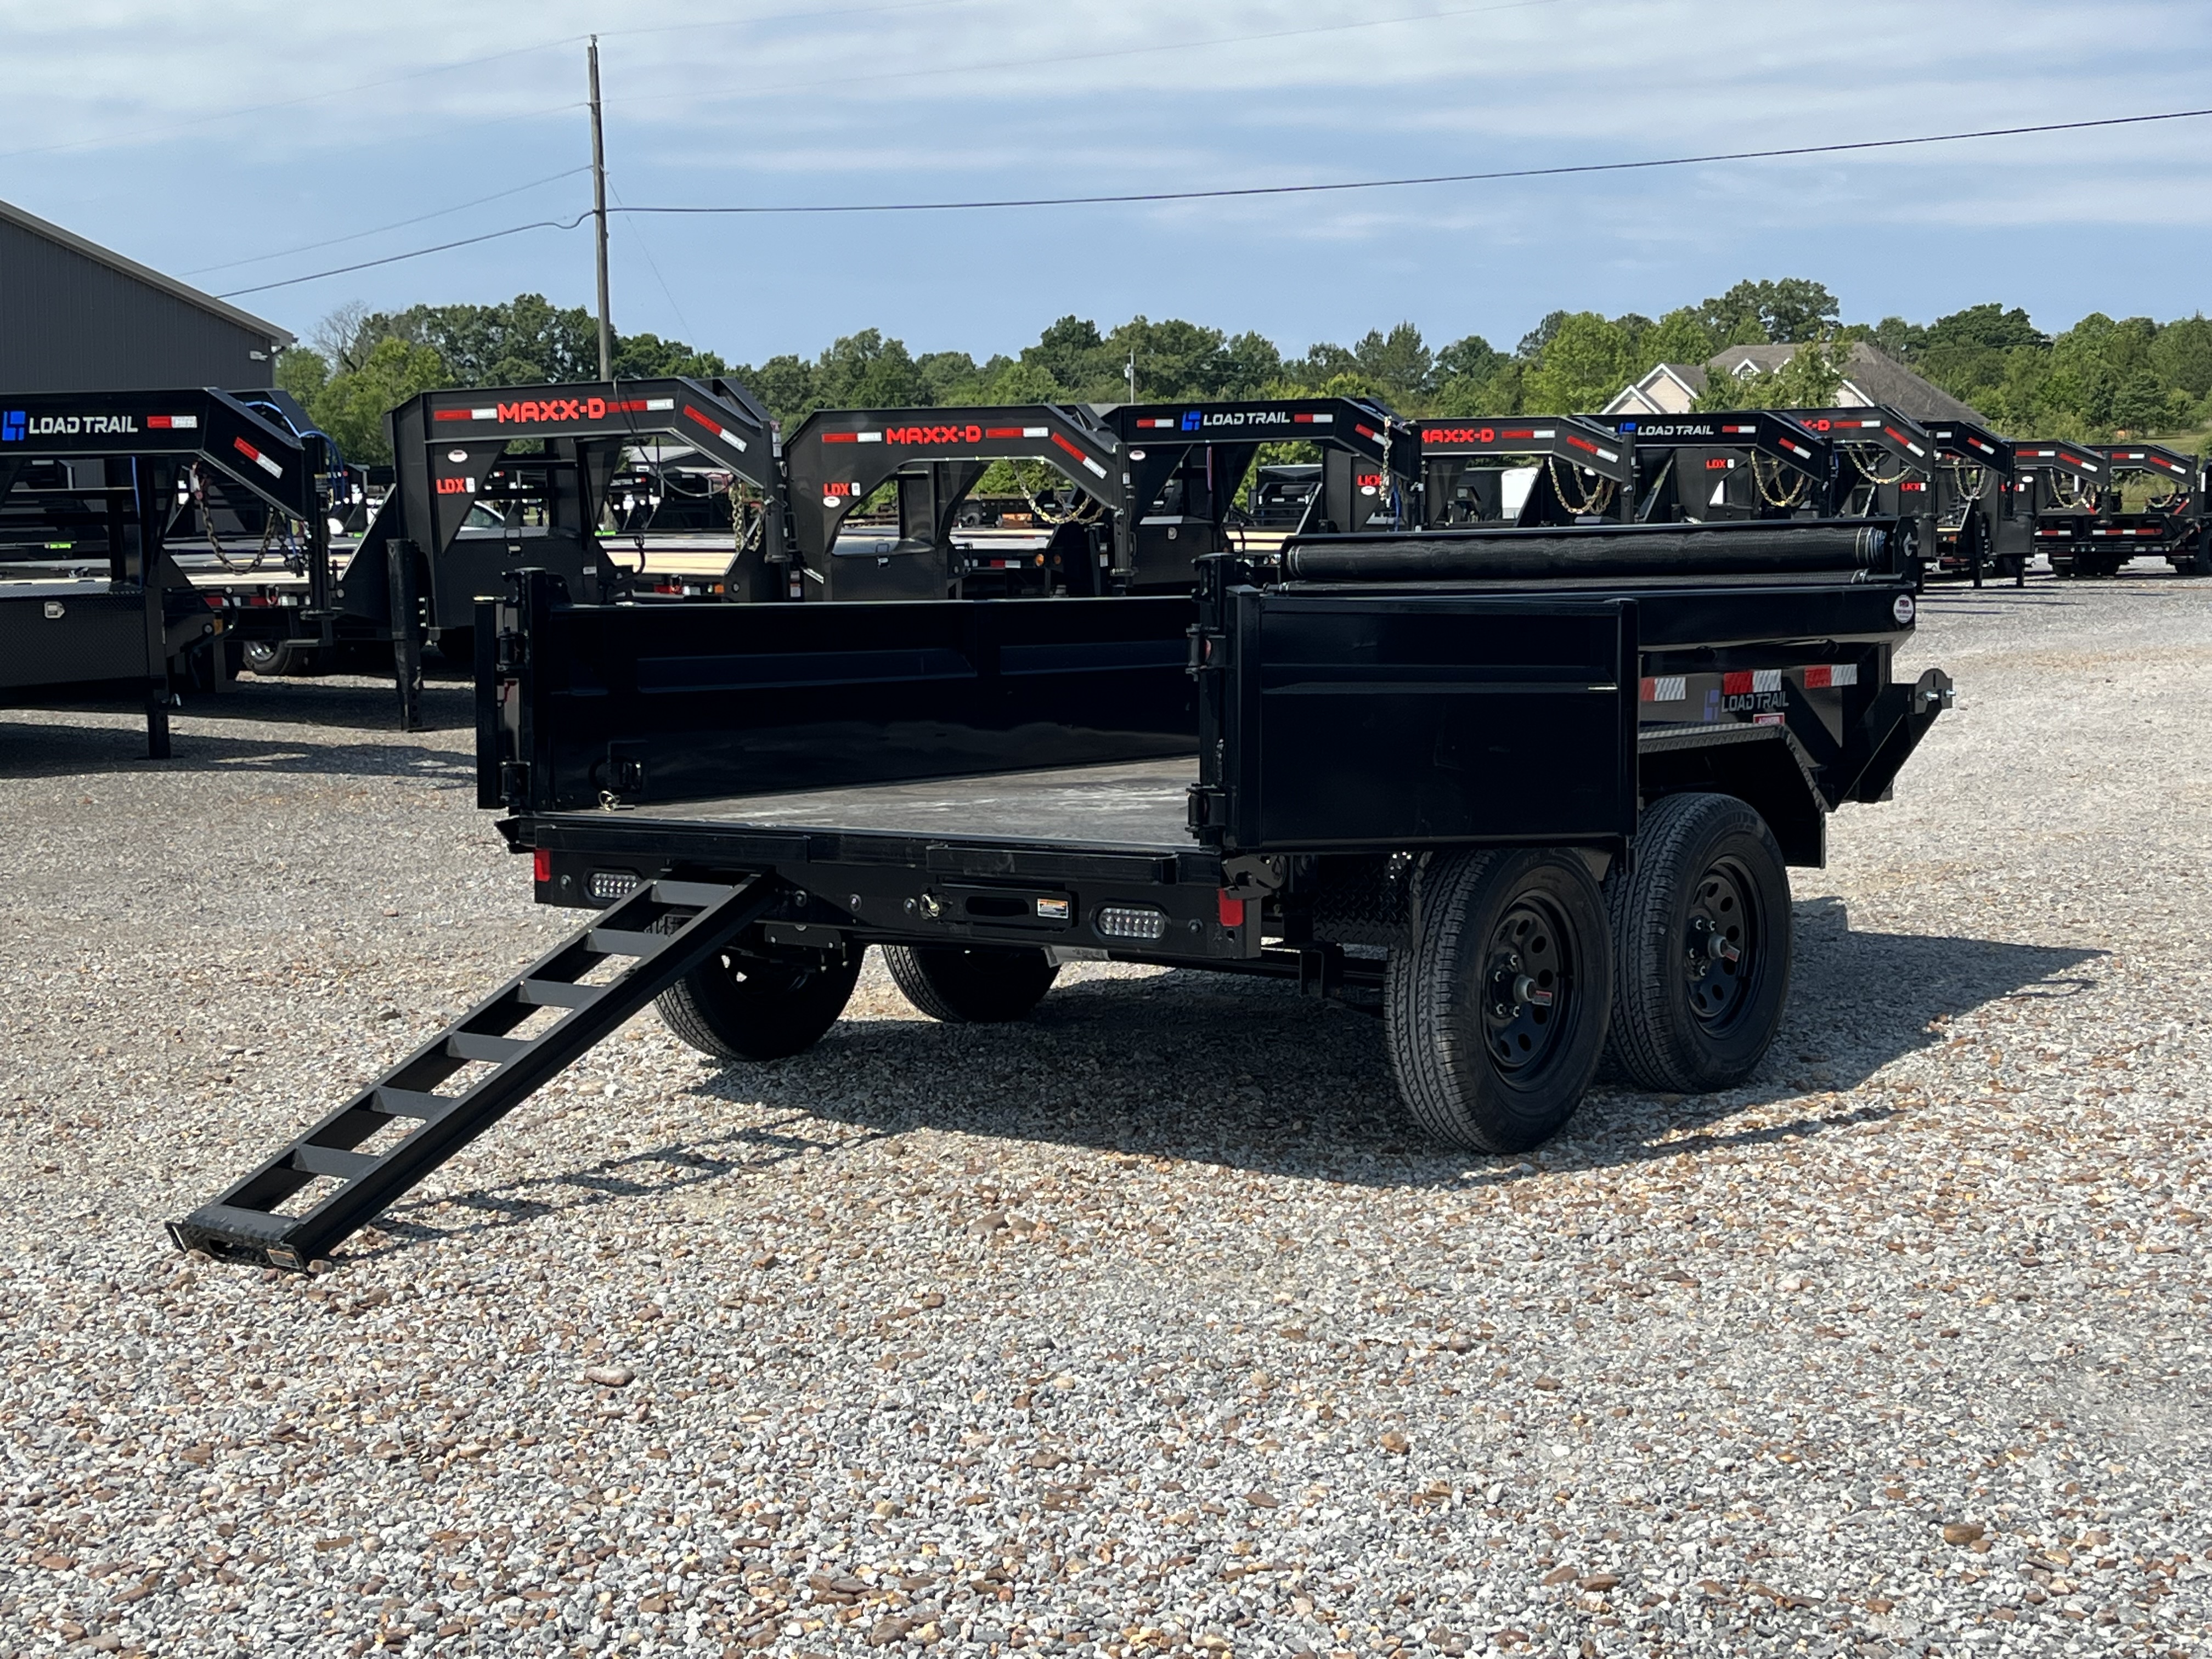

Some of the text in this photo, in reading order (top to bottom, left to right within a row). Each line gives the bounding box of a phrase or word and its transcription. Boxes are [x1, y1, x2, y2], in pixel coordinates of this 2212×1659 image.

[497, 398, 605, 423] MAXX-D
[1203, 411, 1290, 426] LOAD TRAIL
[29, 415, 139, 434] LOAD TRAIL
[1637, 425, 1714, 436] LOAD TRAIL
[886, 425, 983, 445] MAXX-D
[436, 478, 465, 494] LDX
[823, 483, 850, 496] LDX
[1721, 691, 1790, 713] LOAD TRAIL
